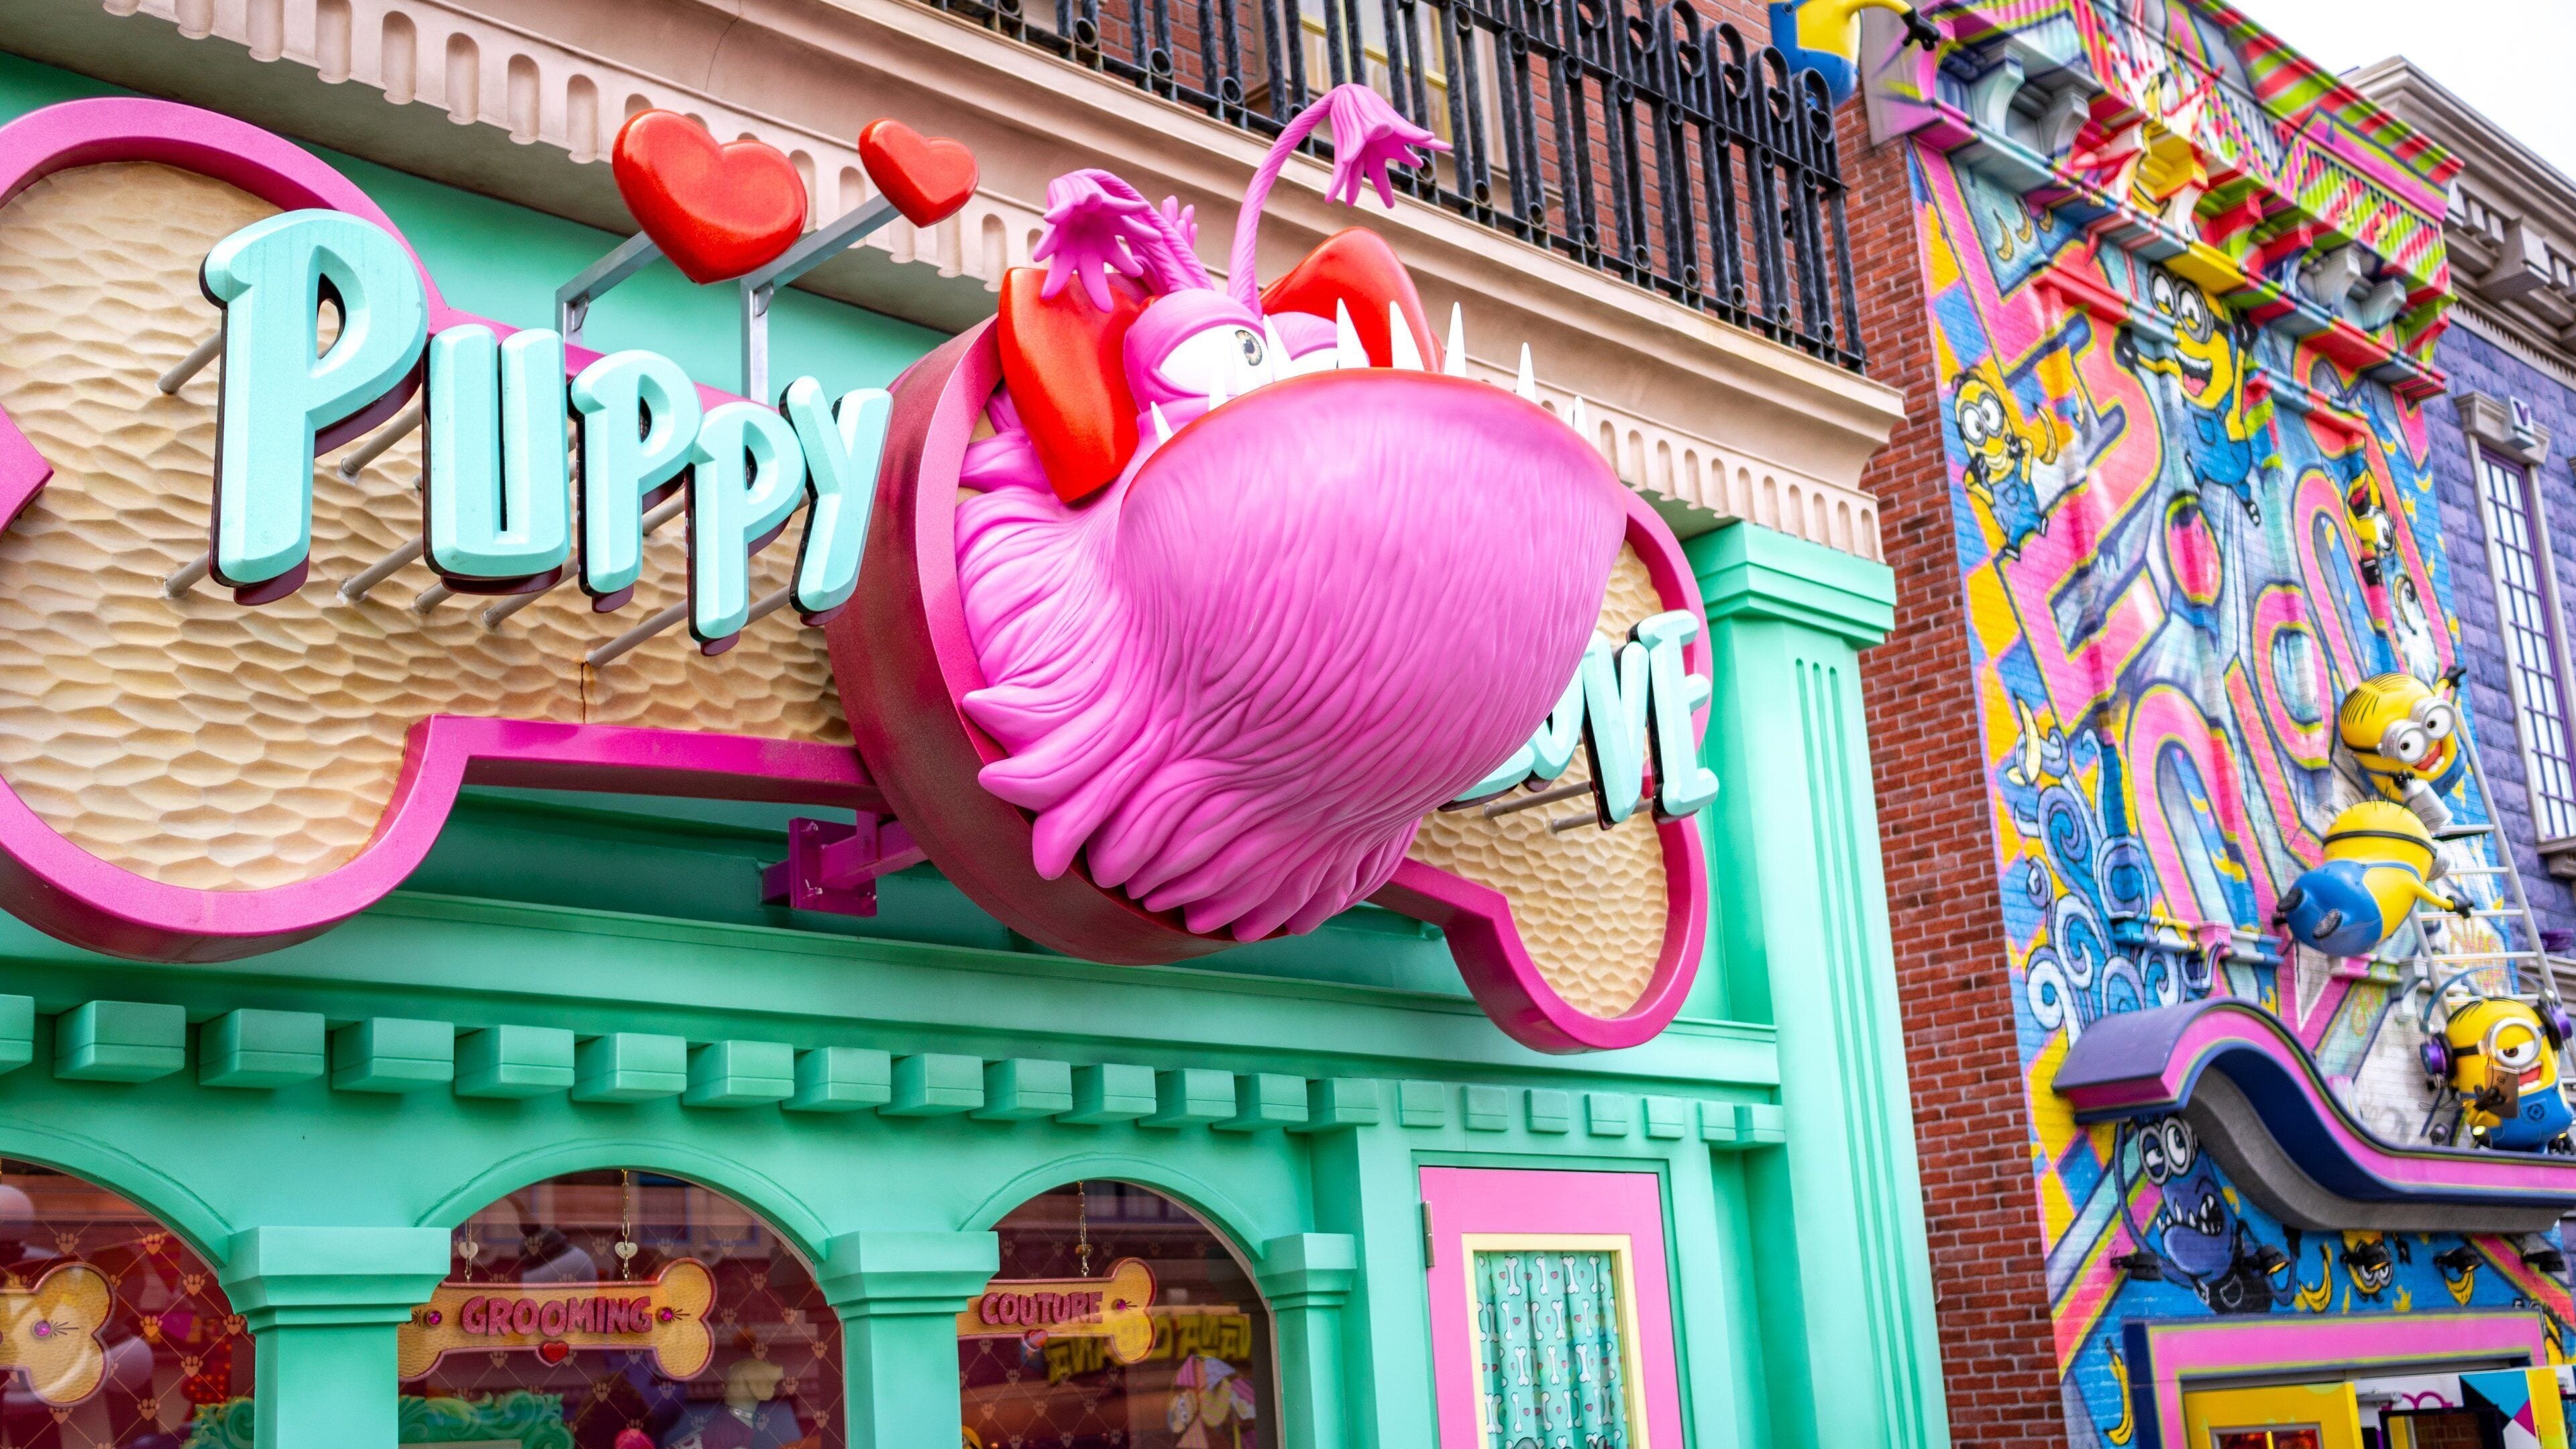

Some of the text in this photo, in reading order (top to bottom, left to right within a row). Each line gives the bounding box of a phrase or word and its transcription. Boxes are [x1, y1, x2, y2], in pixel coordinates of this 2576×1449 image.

[200, 209, 893, 656] PUPPY
[460, 1295, 653, 1337] GROOMING
[979, 1291, 1103, 1326] COUTURE
